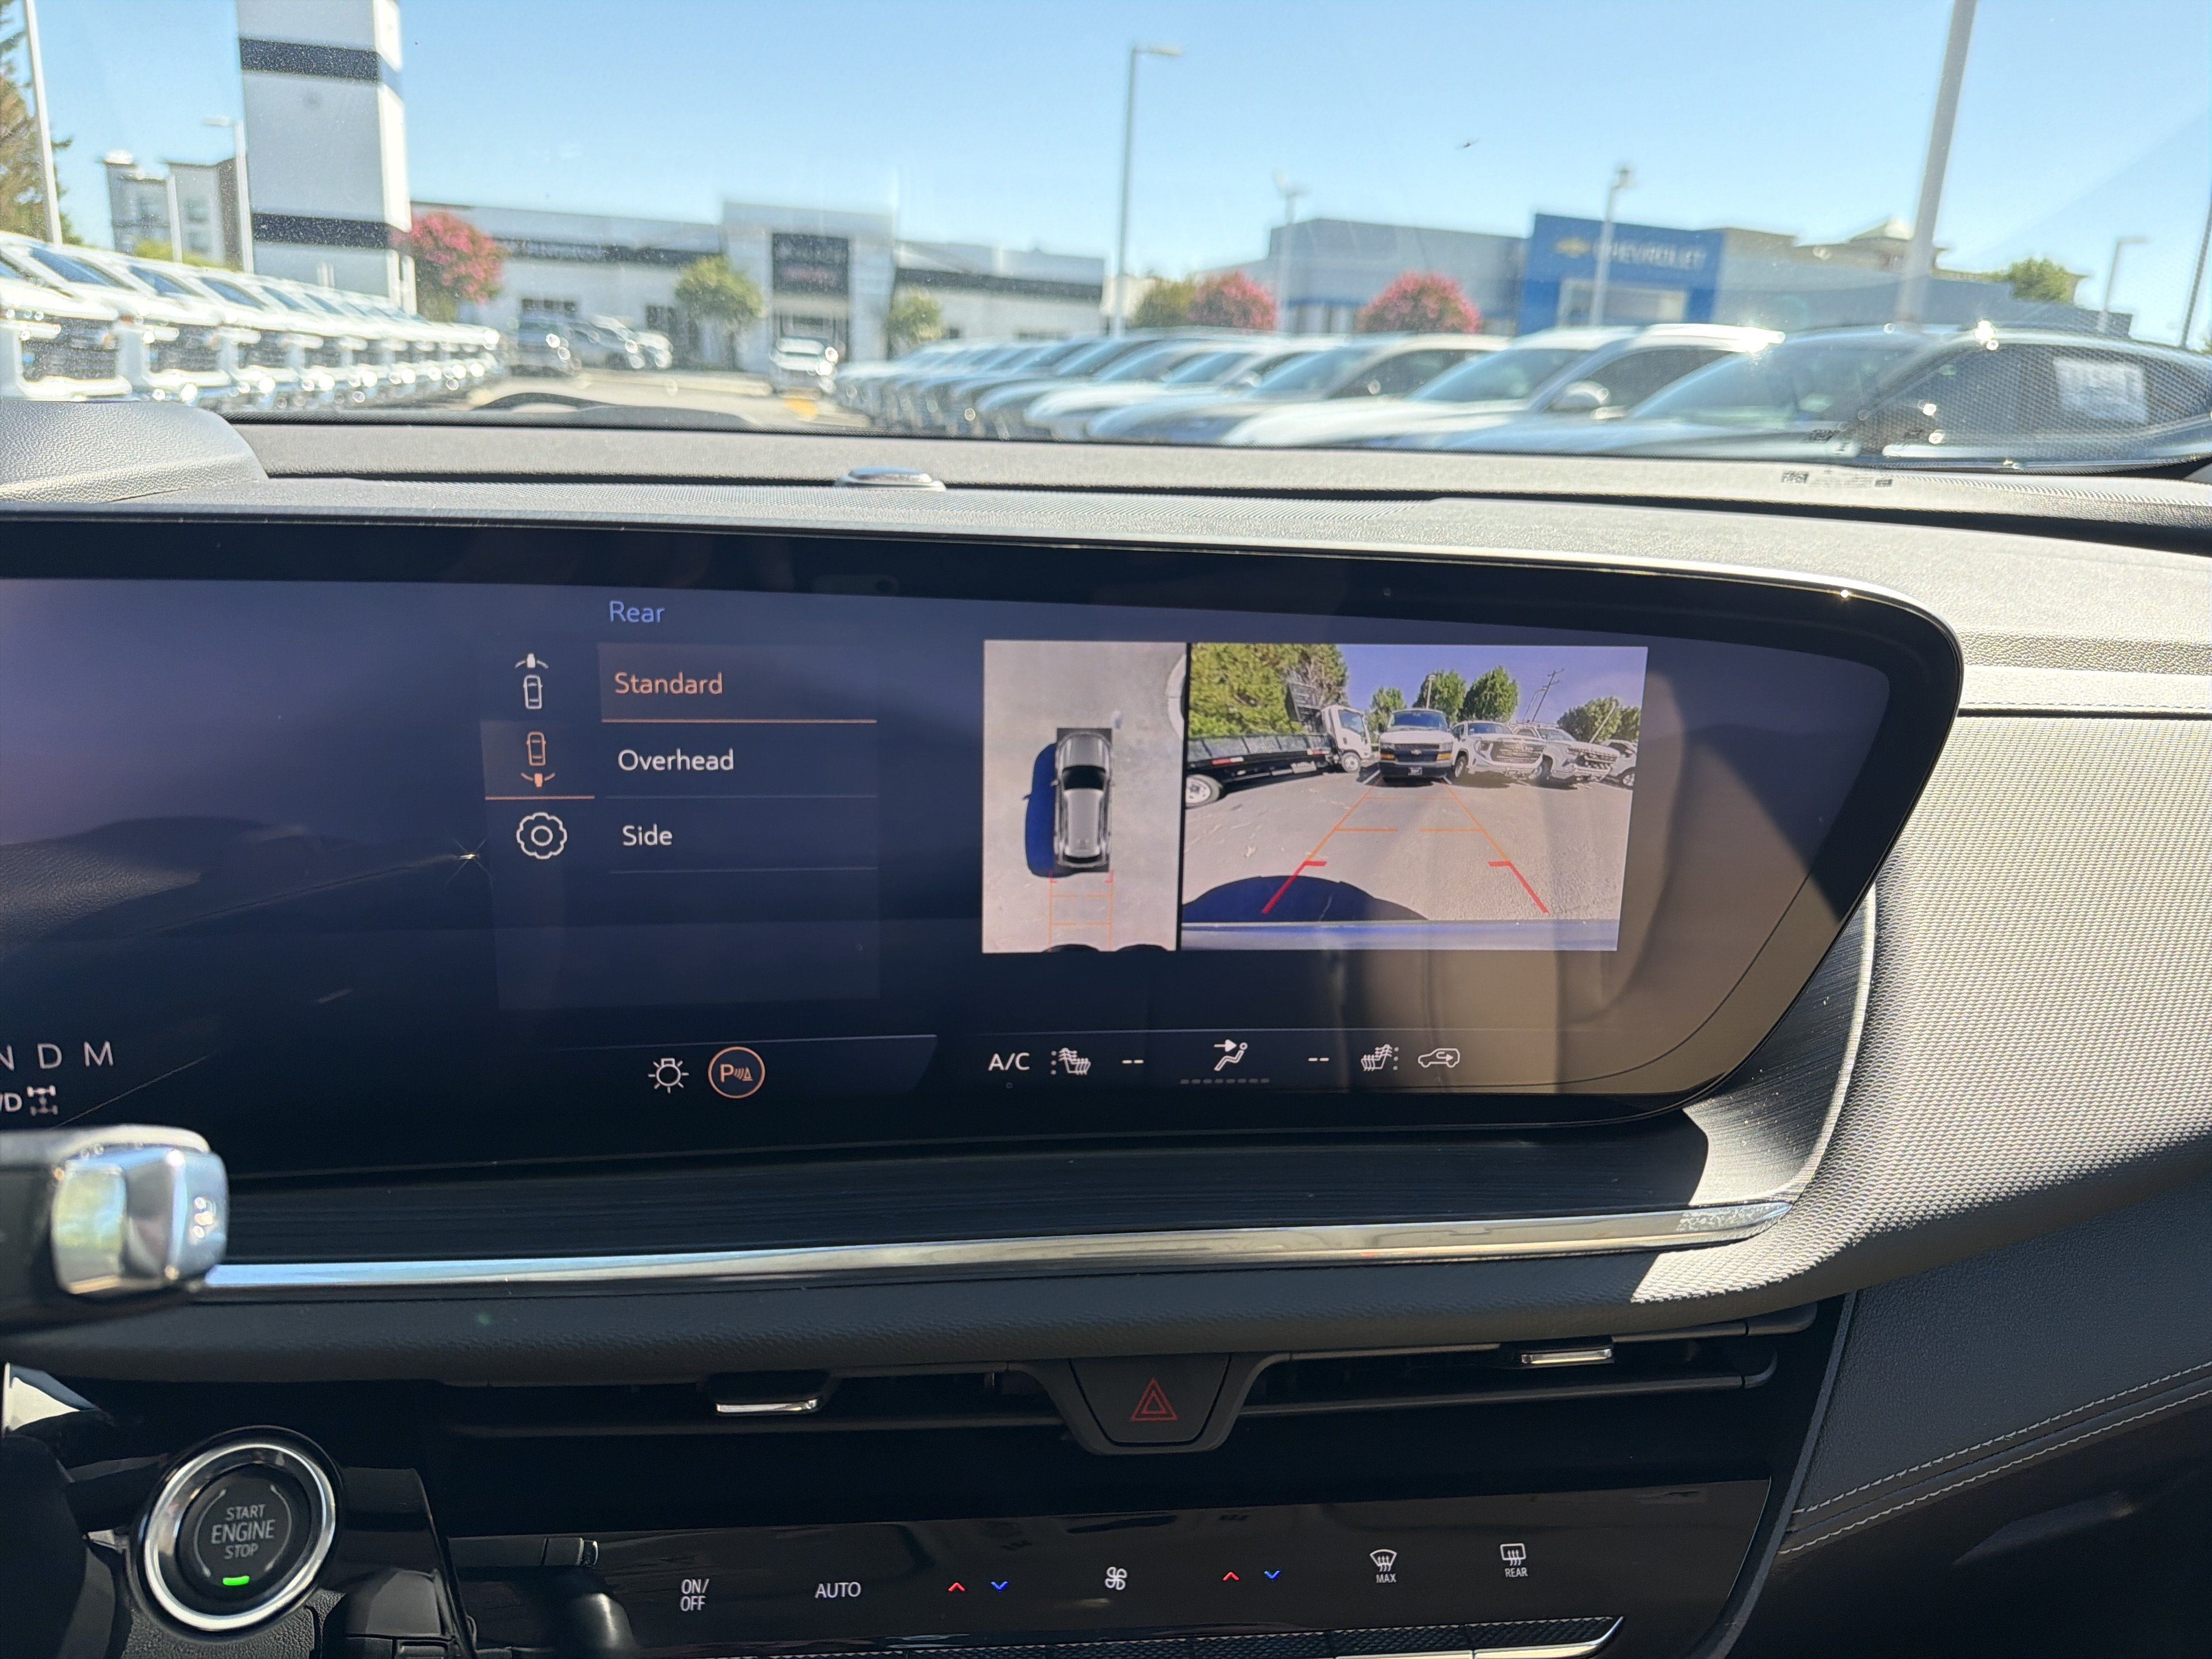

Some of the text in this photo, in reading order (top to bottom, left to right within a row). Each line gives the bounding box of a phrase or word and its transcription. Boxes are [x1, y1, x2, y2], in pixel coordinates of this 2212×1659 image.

[609, 600, 665, 623] Rear
[614, 671, 723, 695] Standard
[618, 748, 734, 771] Overhead
[622, 823, 673, 846] Side
[0, 1041, 114, 1071] N D M
[988, 1053, 1030, 1071] A/C
[0, 1092, 22, 1112] D
[225, 1504, 266, 1521] START
[211, 1519, 276, 1544] ENGINE
[224, 1543, 259, 1560] STOP
[1376, 1573, 1397, 1583] MAX
[1505, 1567, 1528, 1577] REAR
[681, 1579, 709, 1594] ON/
[814, 1582, 861, 1599] AUTO
[680, 1595, 706, 1612] OFF
